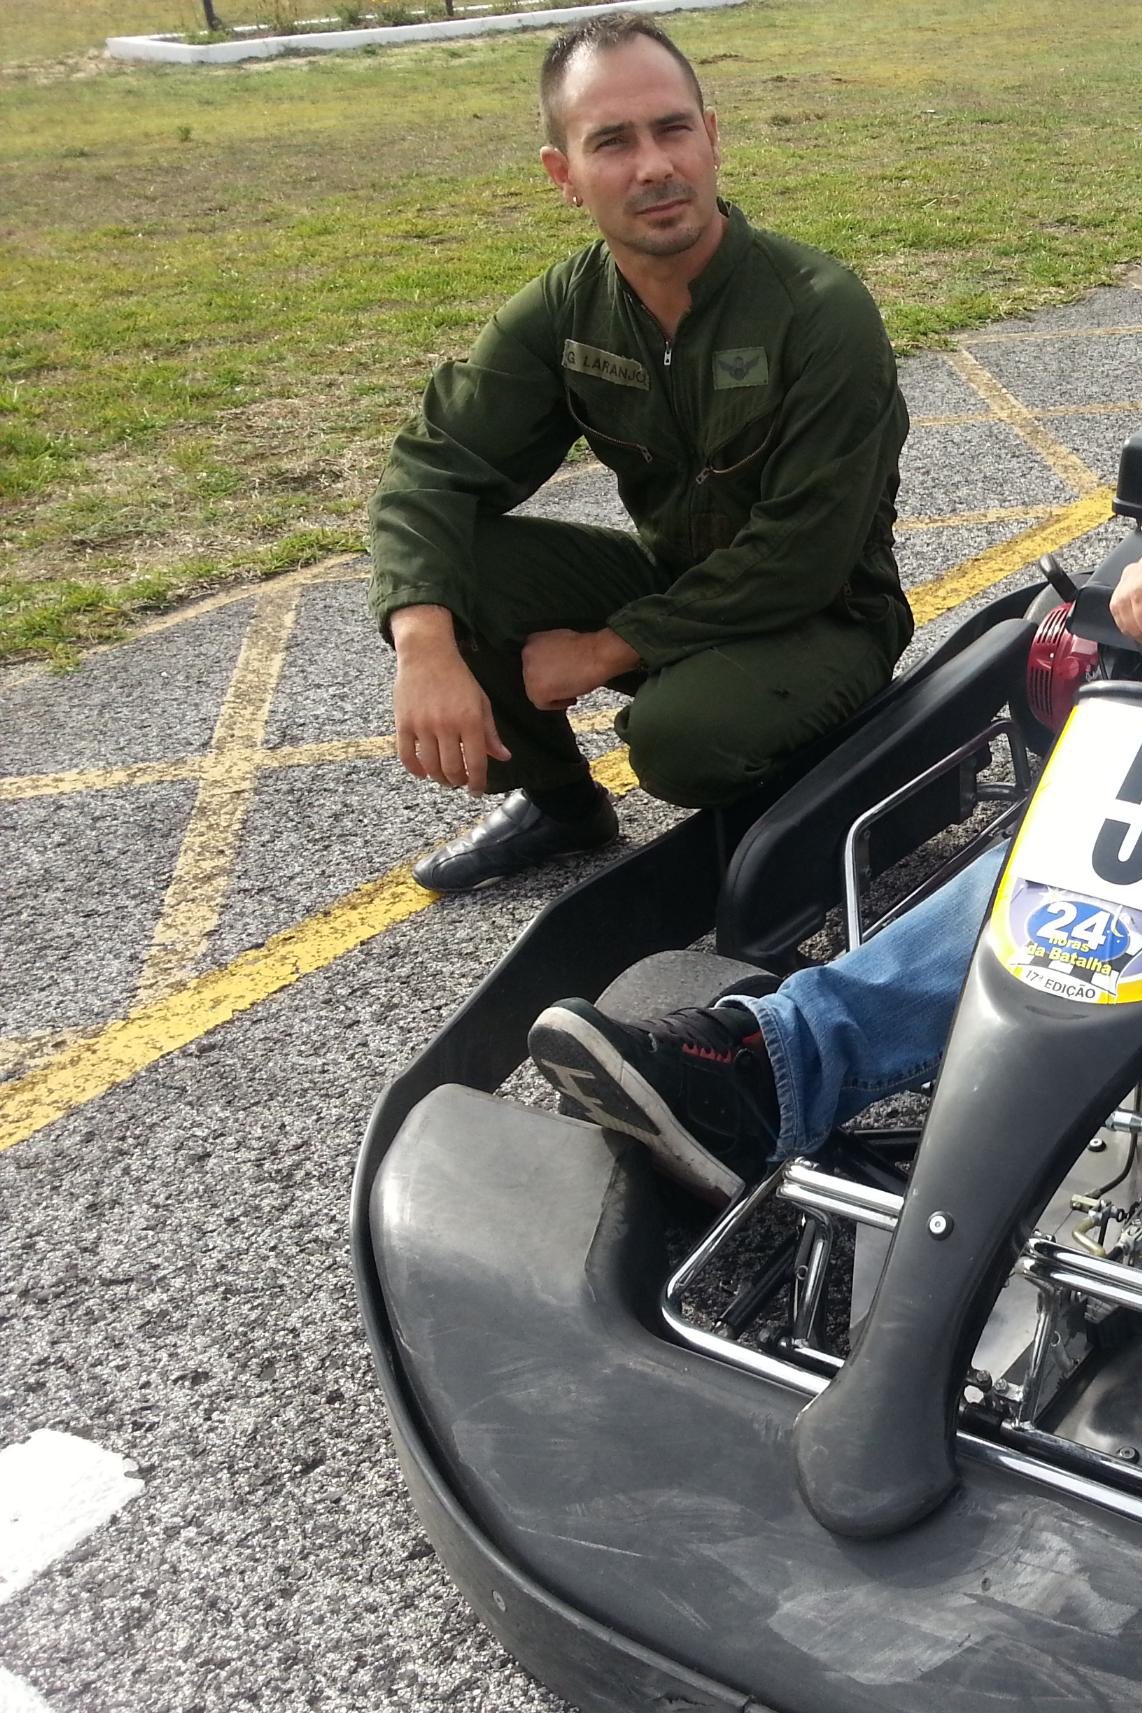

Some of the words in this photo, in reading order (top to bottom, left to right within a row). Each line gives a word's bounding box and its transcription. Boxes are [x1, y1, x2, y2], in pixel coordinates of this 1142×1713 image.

[582, 355, 646, 383] LARANJO
[1036, 901, 1111, 950] 24
[1026, 943, 1045, 957] da
[1048, 948, 1113, 976] Batalha
[1044, 979, 1096, 999] EDIÇÃO
